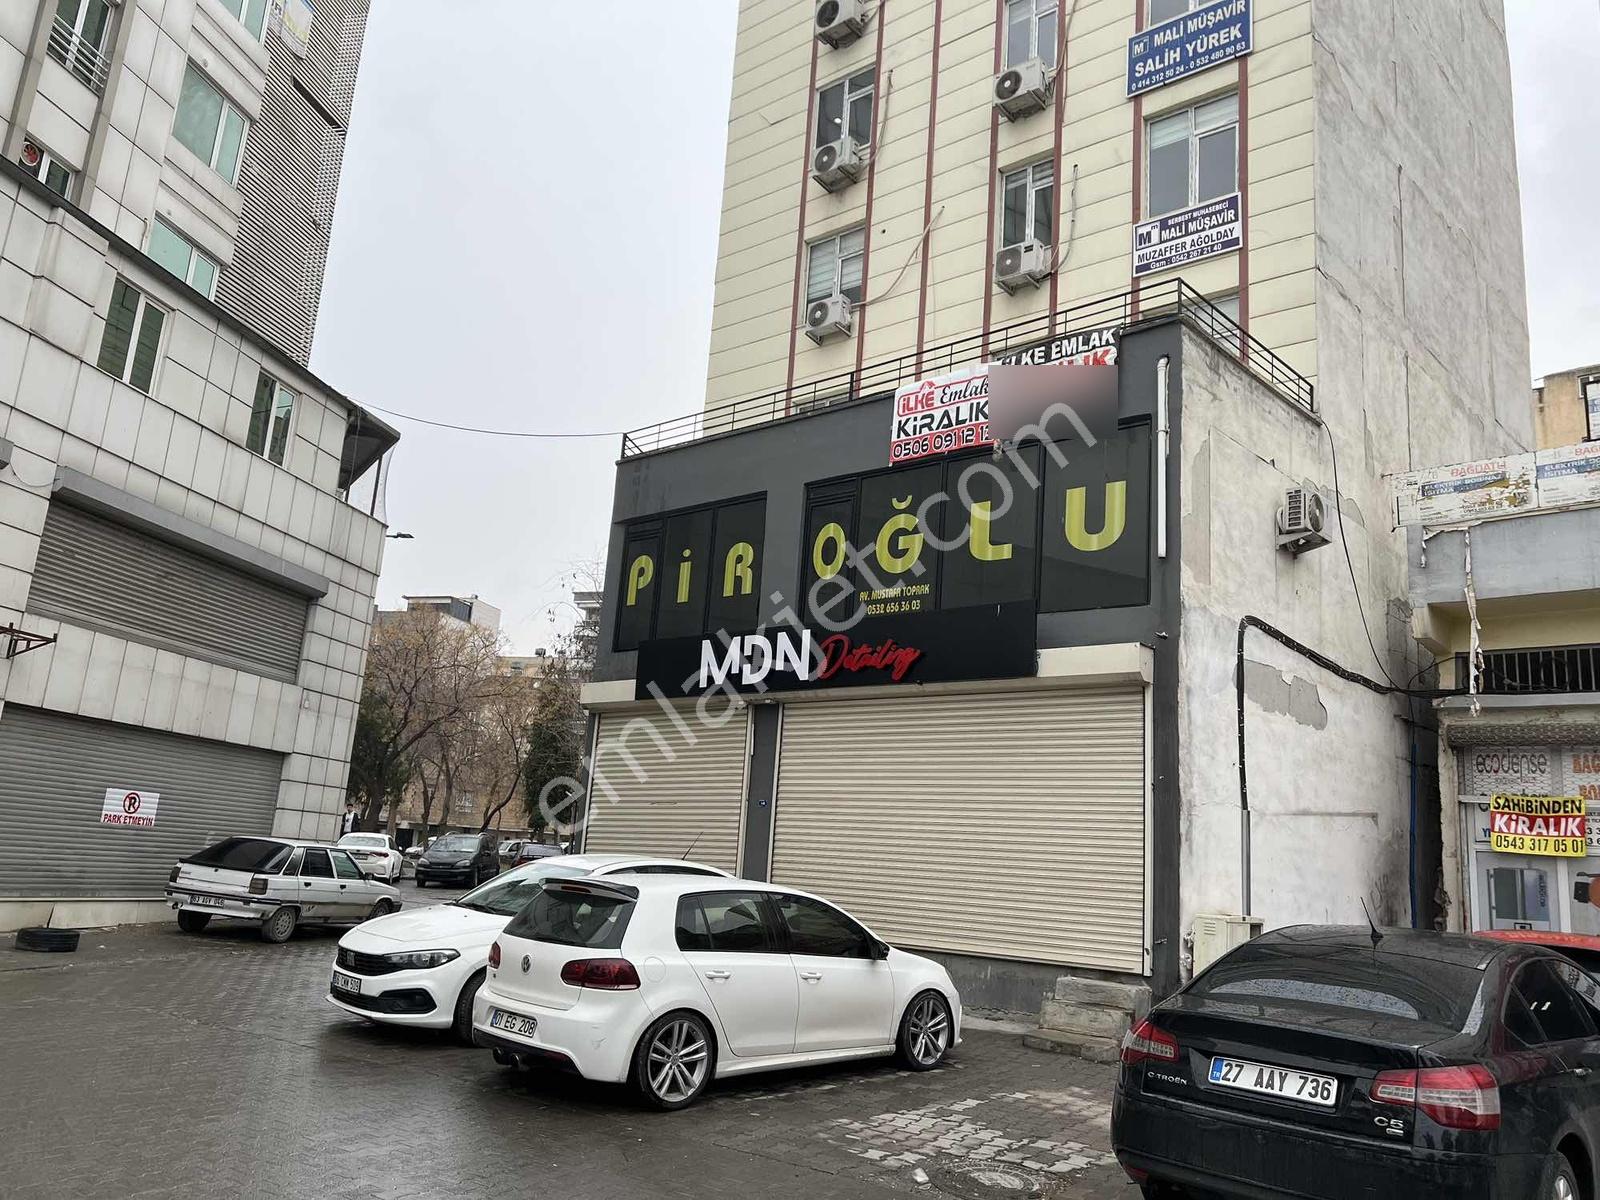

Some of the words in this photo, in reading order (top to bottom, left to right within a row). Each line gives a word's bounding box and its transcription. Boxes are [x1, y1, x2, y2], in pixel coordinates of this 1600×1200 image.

[1154, 21, 1183, 47] MALİ
[1187, 0, 1246, 33] MÜŞAVİR
[1135, 48, 1180, 77] SALİH
[1186, 23, 1242, 57] YÜREK
[1138, 79, 1150, 88] 414
[1152, 73, 1164, 83] 312
[1175, 65, 1184, 74] 24
[1196, 56, 1209, 66] 532
[1161, 221, 1185, 241] MALİ
[1188, 209, 1235, 233] MÜŞAVİR
[1138, 241, 1187, 264] MUZAFFER
[1150, 260, 1166, 269] Gsm
[1051, 328, 1117, 360] EMLAK
[940, 375, 988, 404] Emlak
[893, 437, 929, 458] 0506
[933, 430, 957, 450] 091
[961, 427, 975, 444] 12
[871, 586, 901, 600] MUSTAFA
[885, 602, 899, 613] 656
[900, 601, 910, 611] 36
[911, 600, 920, 610] 03
[699, 629, 811, 688] MDN
[818, 633, 920, 681] Detailing
[103, 813, 122, 823] PARK
[1496, 835, 1525, 850] 0543
[1529, 837, 1549, 852] 317
[1554, 838, 1567, 853] 05
[1572, 839, 1584, 854] 01
[495, 1011, 503, 1026] 01
[504, 1015, 517, 1029] EG
[518, 1019, 536, 1035] 208
[1222, 1062, 1244, 1082] 27
[1254, 1068, 1288, 1092] AAY
[1296, 1075, 1331, 1101] 736
[1374, 1116, 1404, 1129] C5
